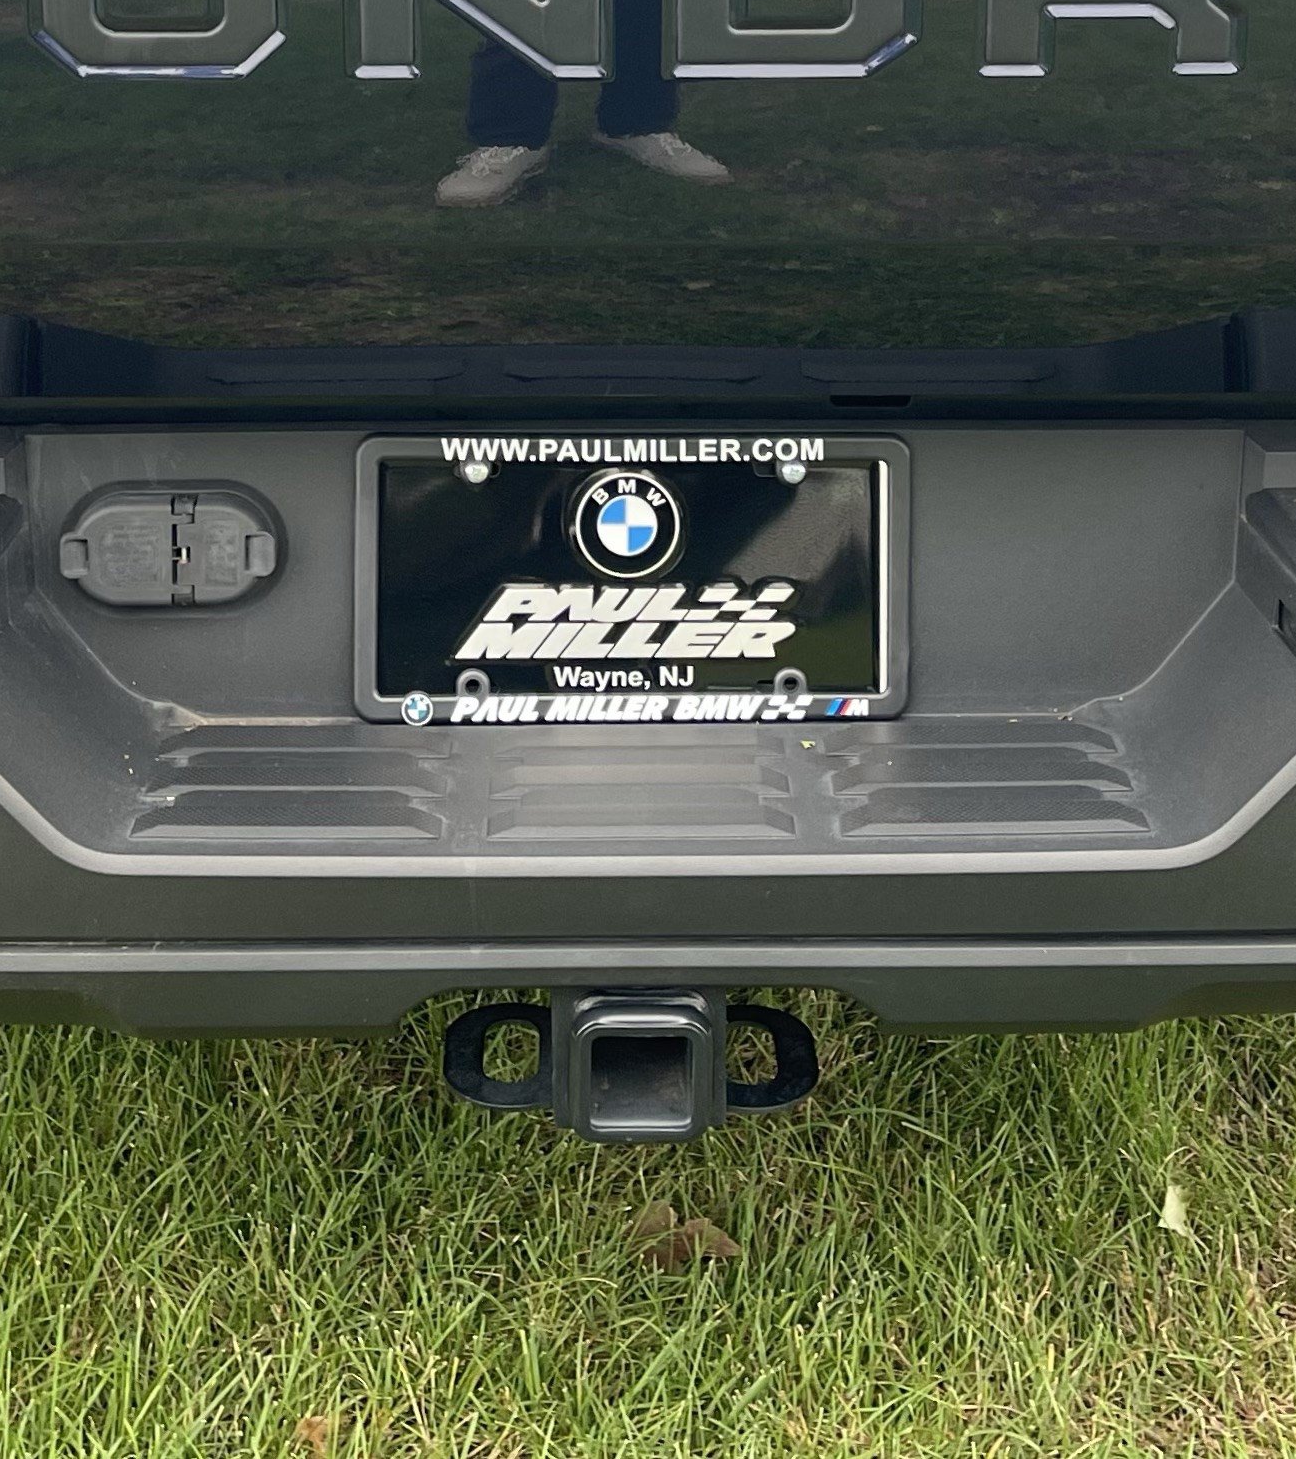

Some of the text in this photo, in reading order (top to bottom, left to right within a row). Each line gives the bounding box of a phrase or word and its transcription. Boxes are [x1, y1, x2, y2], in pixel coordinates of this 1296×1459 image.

[441, 437, 825, 463] WWW.PAULMILLER.COM
[591, 479, 667, 508] BMW
[483, 588, 689, 622] PAUL
[454, 622, 796, 659] MILLER
[553, 666, 694, 692] Wayne, NJ
[450, 696, 540, 722] PAUL
[544, 696, 669, 722] MILLER
[672, 696, 760, 721] BMW
